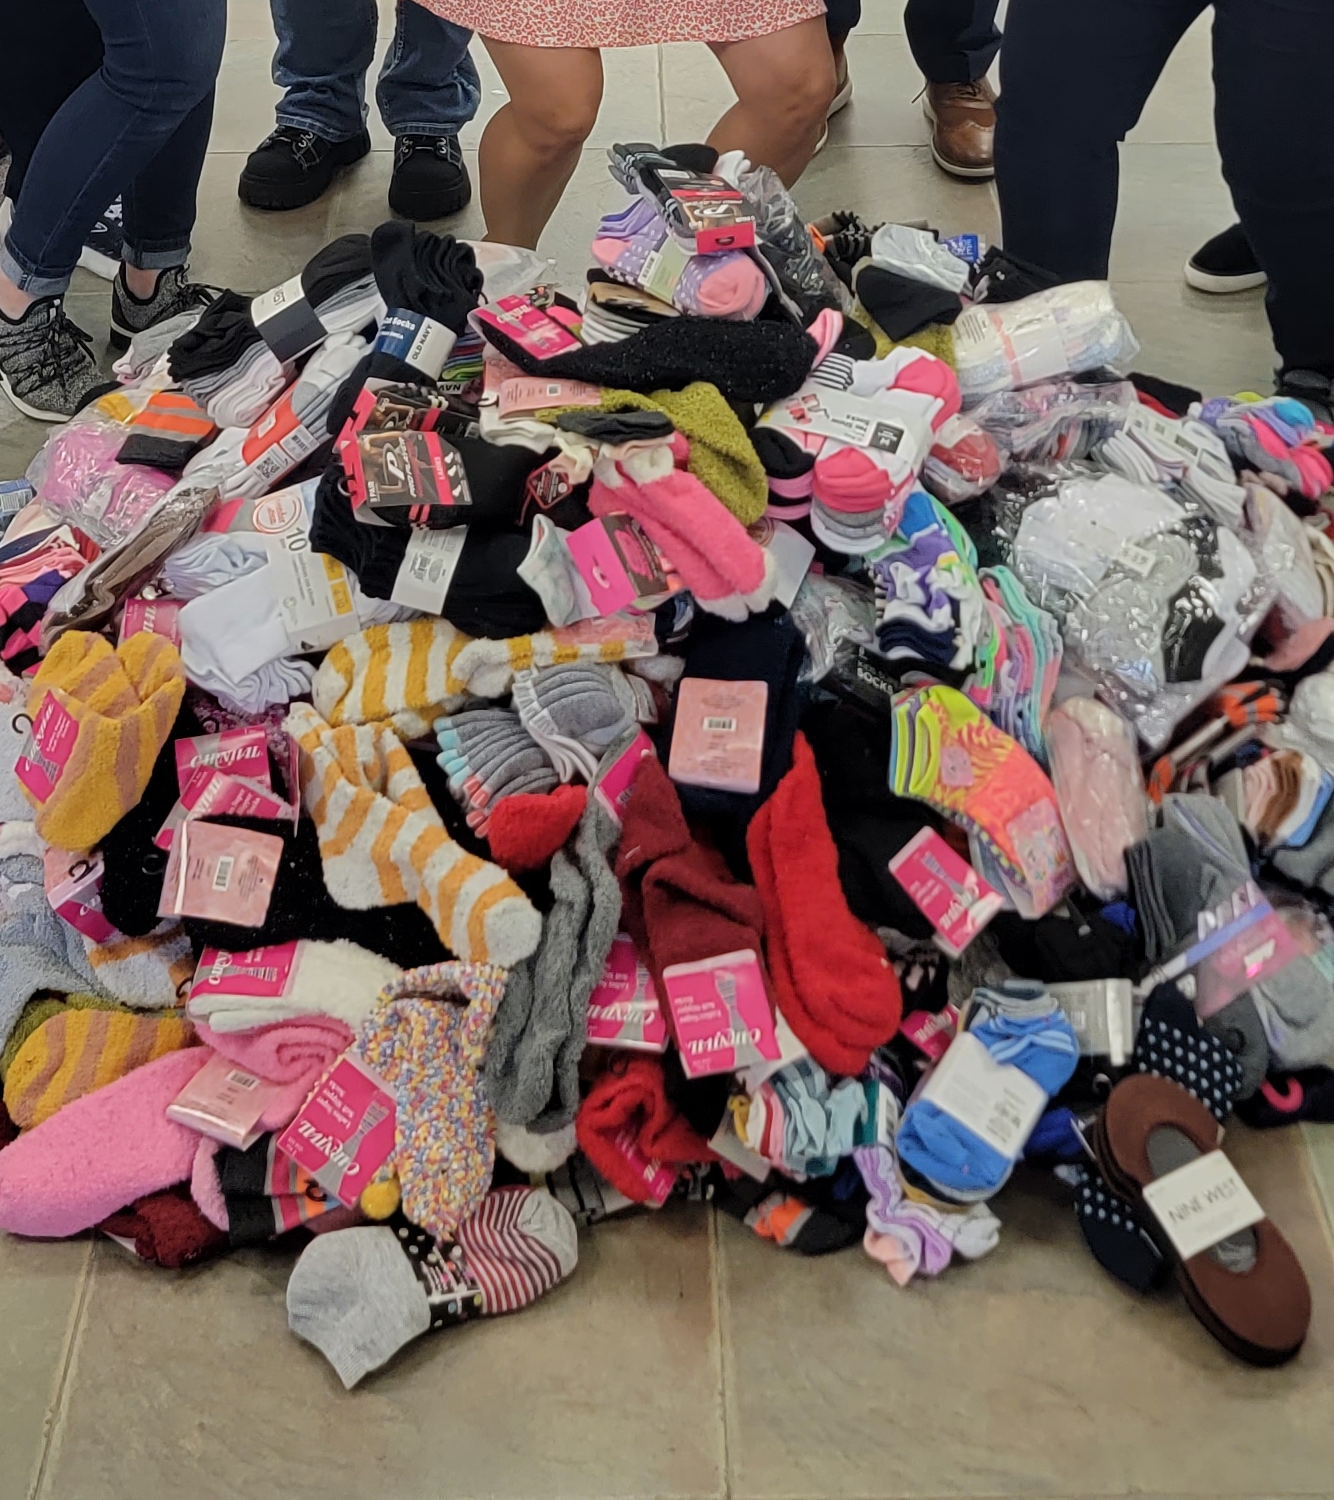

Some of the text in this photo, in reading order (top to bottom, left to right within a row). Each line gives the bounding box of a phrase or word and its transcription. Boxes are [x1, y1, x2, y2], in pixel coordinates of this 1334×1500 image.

[411, 323, 434, 361] OLD NAVY
[437, 383, 462, 393] NAV
[433, 456, 447, 480] LADIES
[285, 526, 308, 552] 10
[856, 666, 894, 696] SOCKS
[1167, 1176, 1241, 1224] NINE WEST
